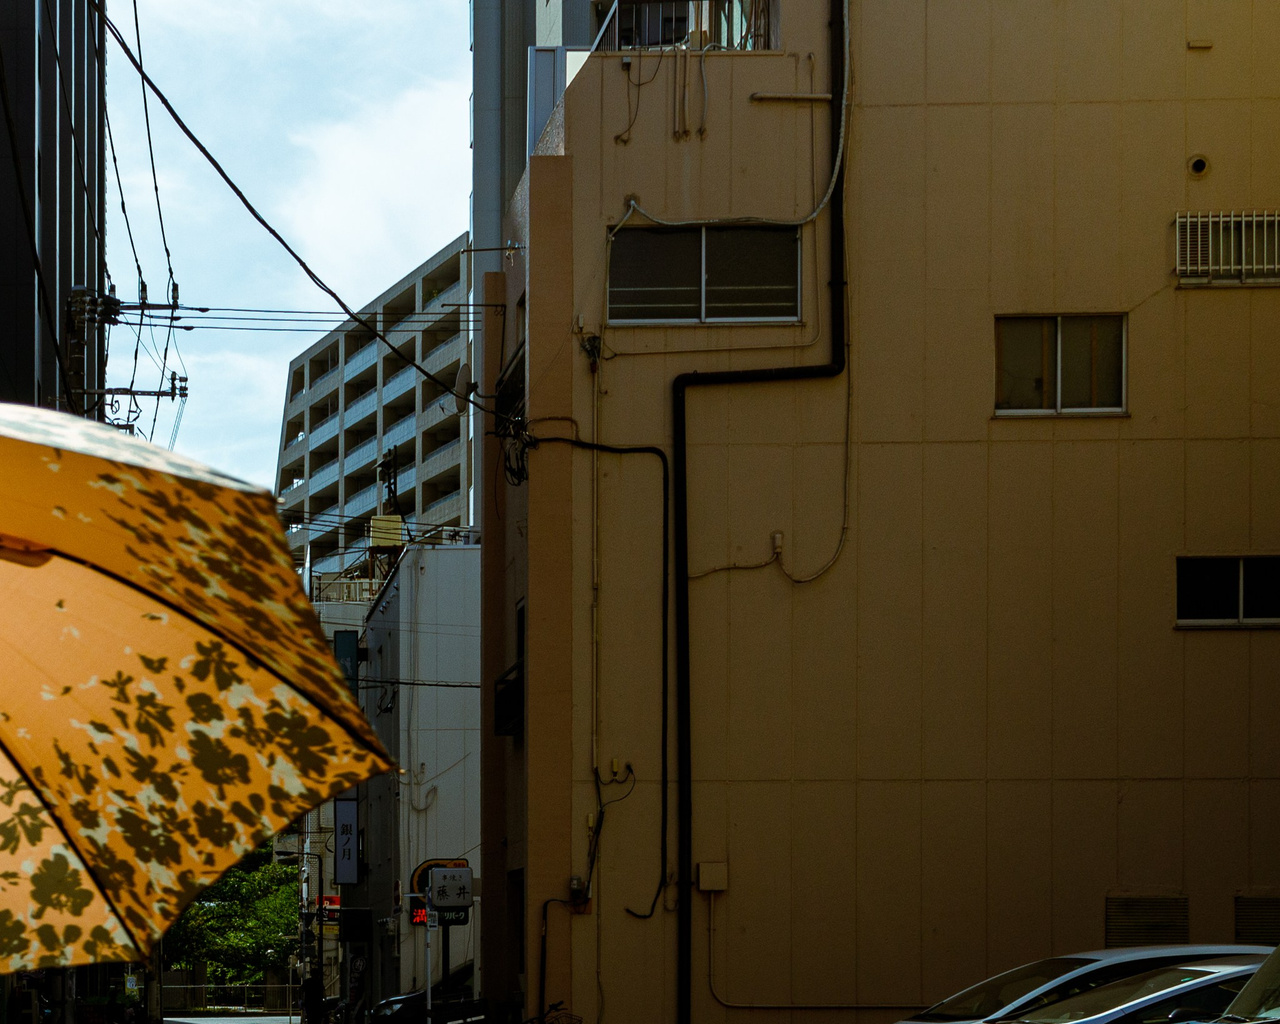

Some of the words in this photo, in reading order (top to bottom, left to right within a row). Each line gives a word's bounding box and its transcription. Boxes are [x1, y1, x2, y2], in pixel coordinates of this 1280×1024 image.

[340, 823, 353, 861] 銀ノ月
[436, 885, 470, 901] 藤井
